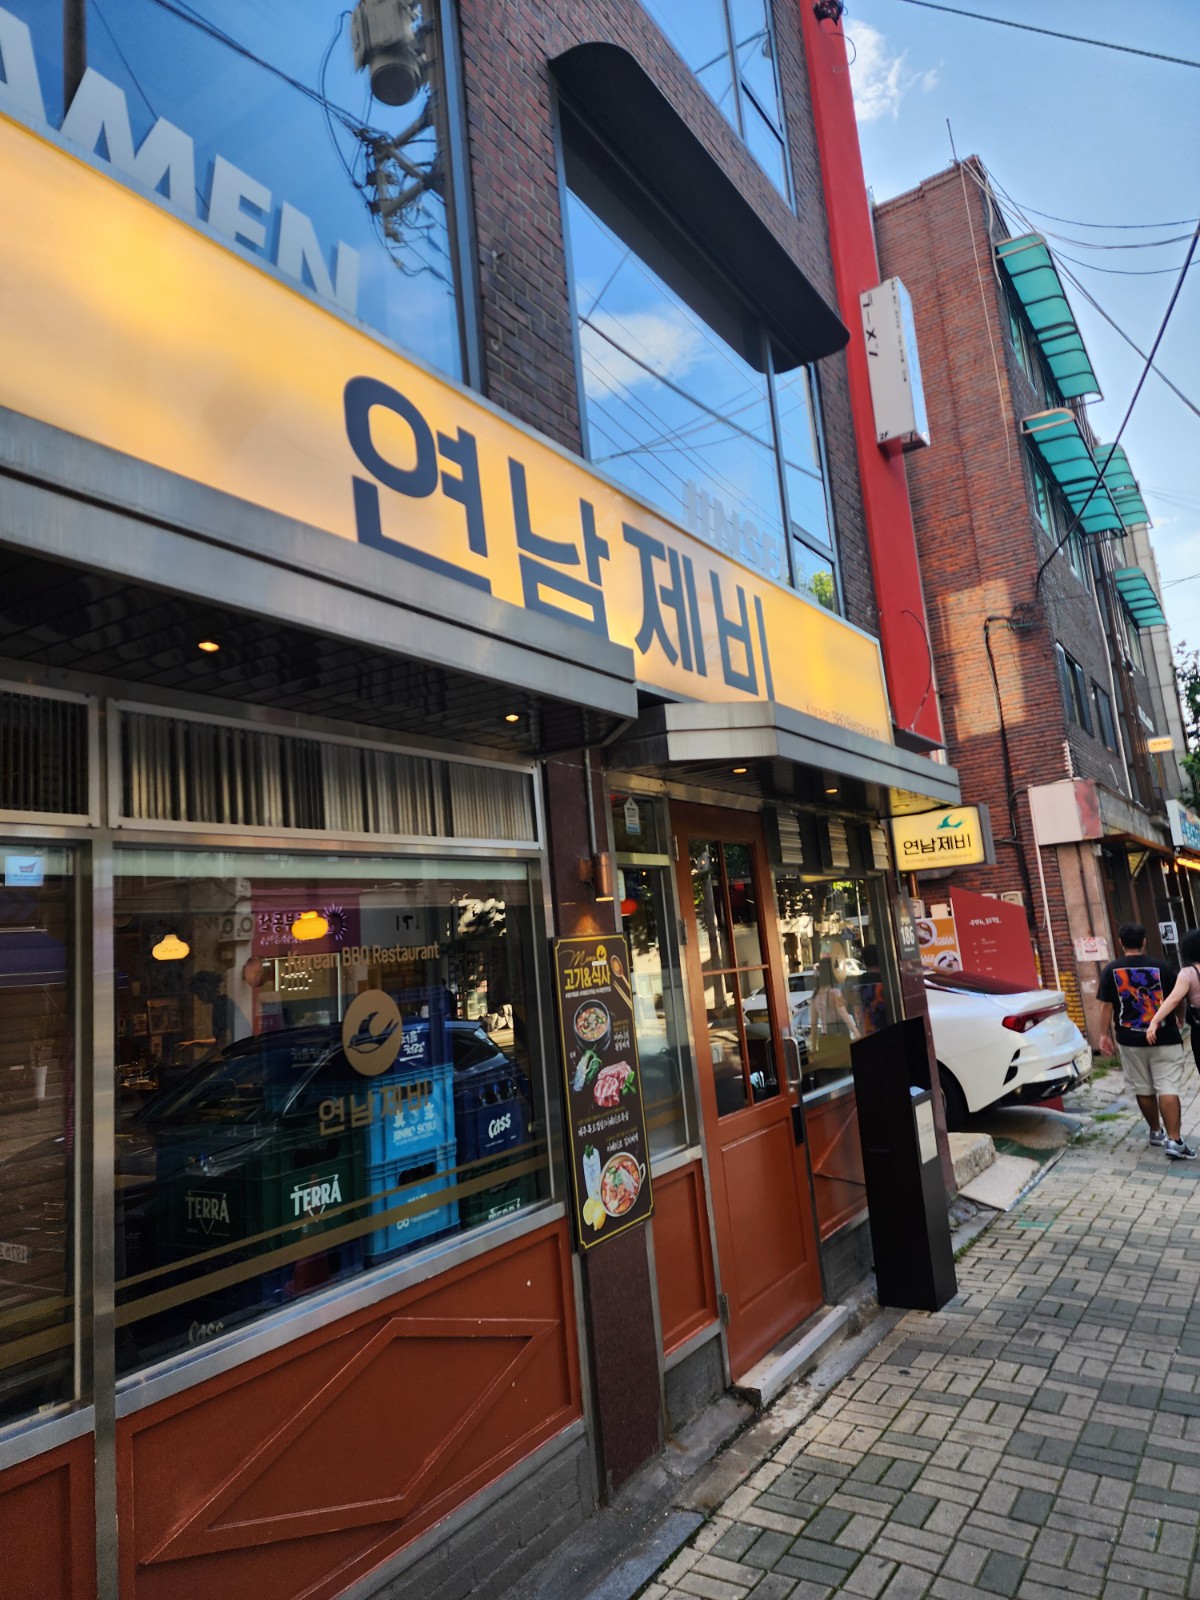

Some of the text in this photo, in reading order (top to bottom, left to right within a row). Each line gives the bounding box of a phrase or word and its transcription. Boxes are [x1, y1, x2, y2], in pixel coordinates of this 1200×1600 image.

[344, 376, 775, 702] 연남제비
[903, 833, 972, 855] 연남제비
[901, 926, 915, 945] 186
[287, 942, 440, 972] Korean BBQ Restaurant
[564, 964, 611, 990] 고기&식사
[318, 1077, 430, 1136] 연남제비
[488, 1113, 511, 1139] Cass
[185, 1196, 230, 1224] TERRA
[290, 1180, 342, 1216] TERRA
